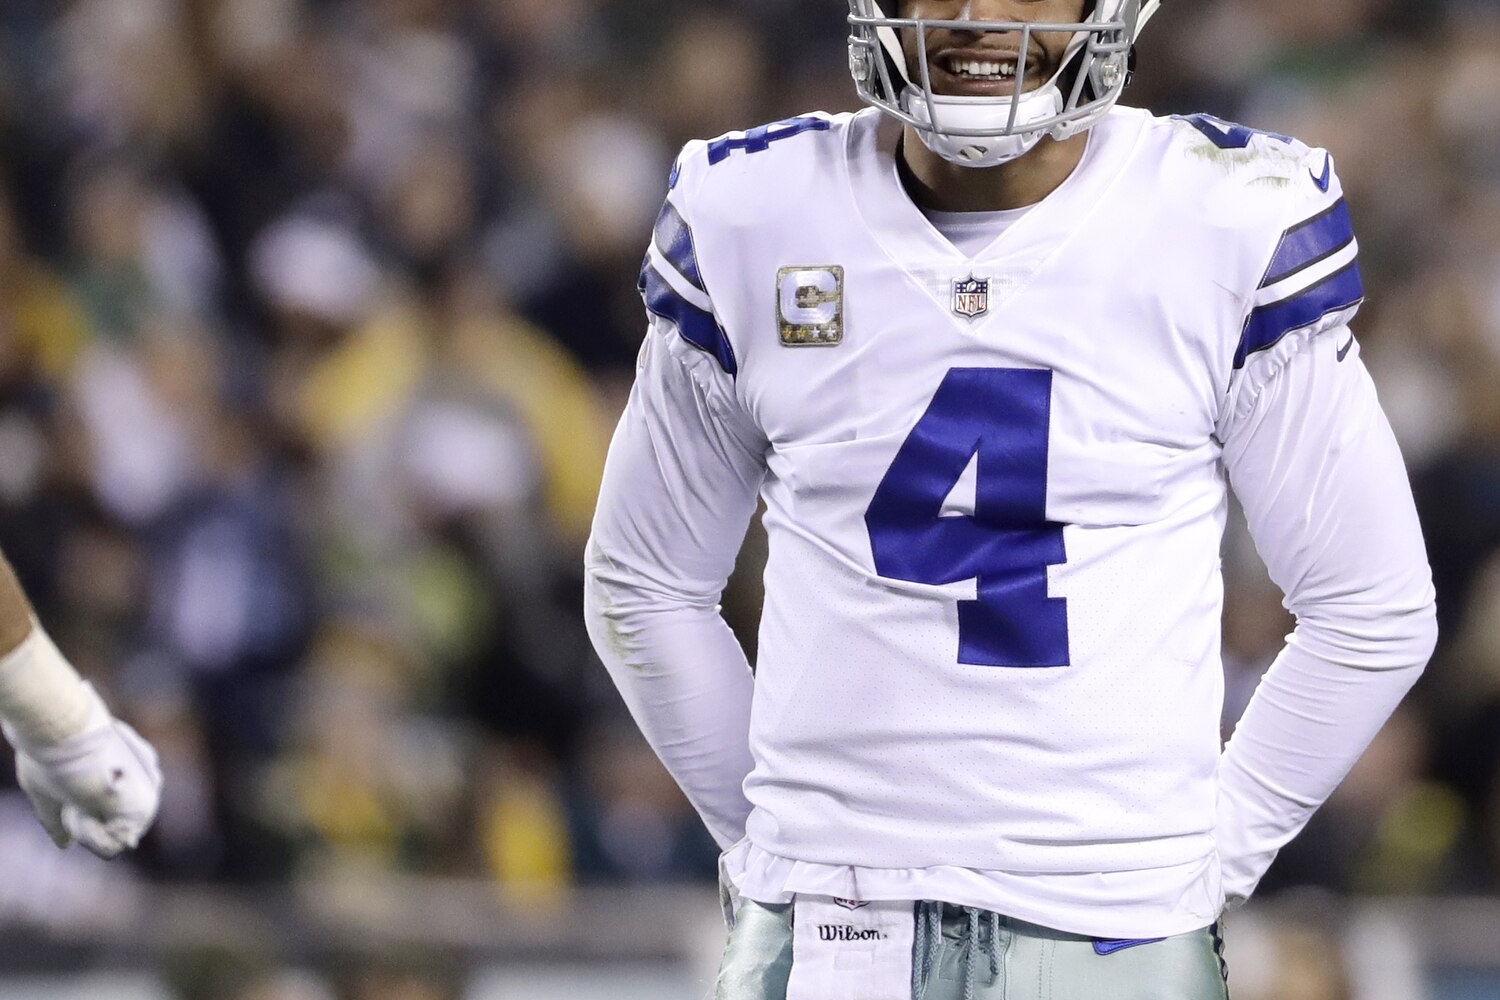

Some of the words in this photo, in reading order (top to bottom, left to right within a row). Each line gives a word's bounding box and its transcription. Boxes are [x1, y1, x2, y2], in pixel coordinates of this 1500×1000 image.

[780, 270, 837, 325] C
[957, 294, 986, 313] NFL
[864, 367, 1070, 667] 4
[818, 924, 881, 941] Wilson
